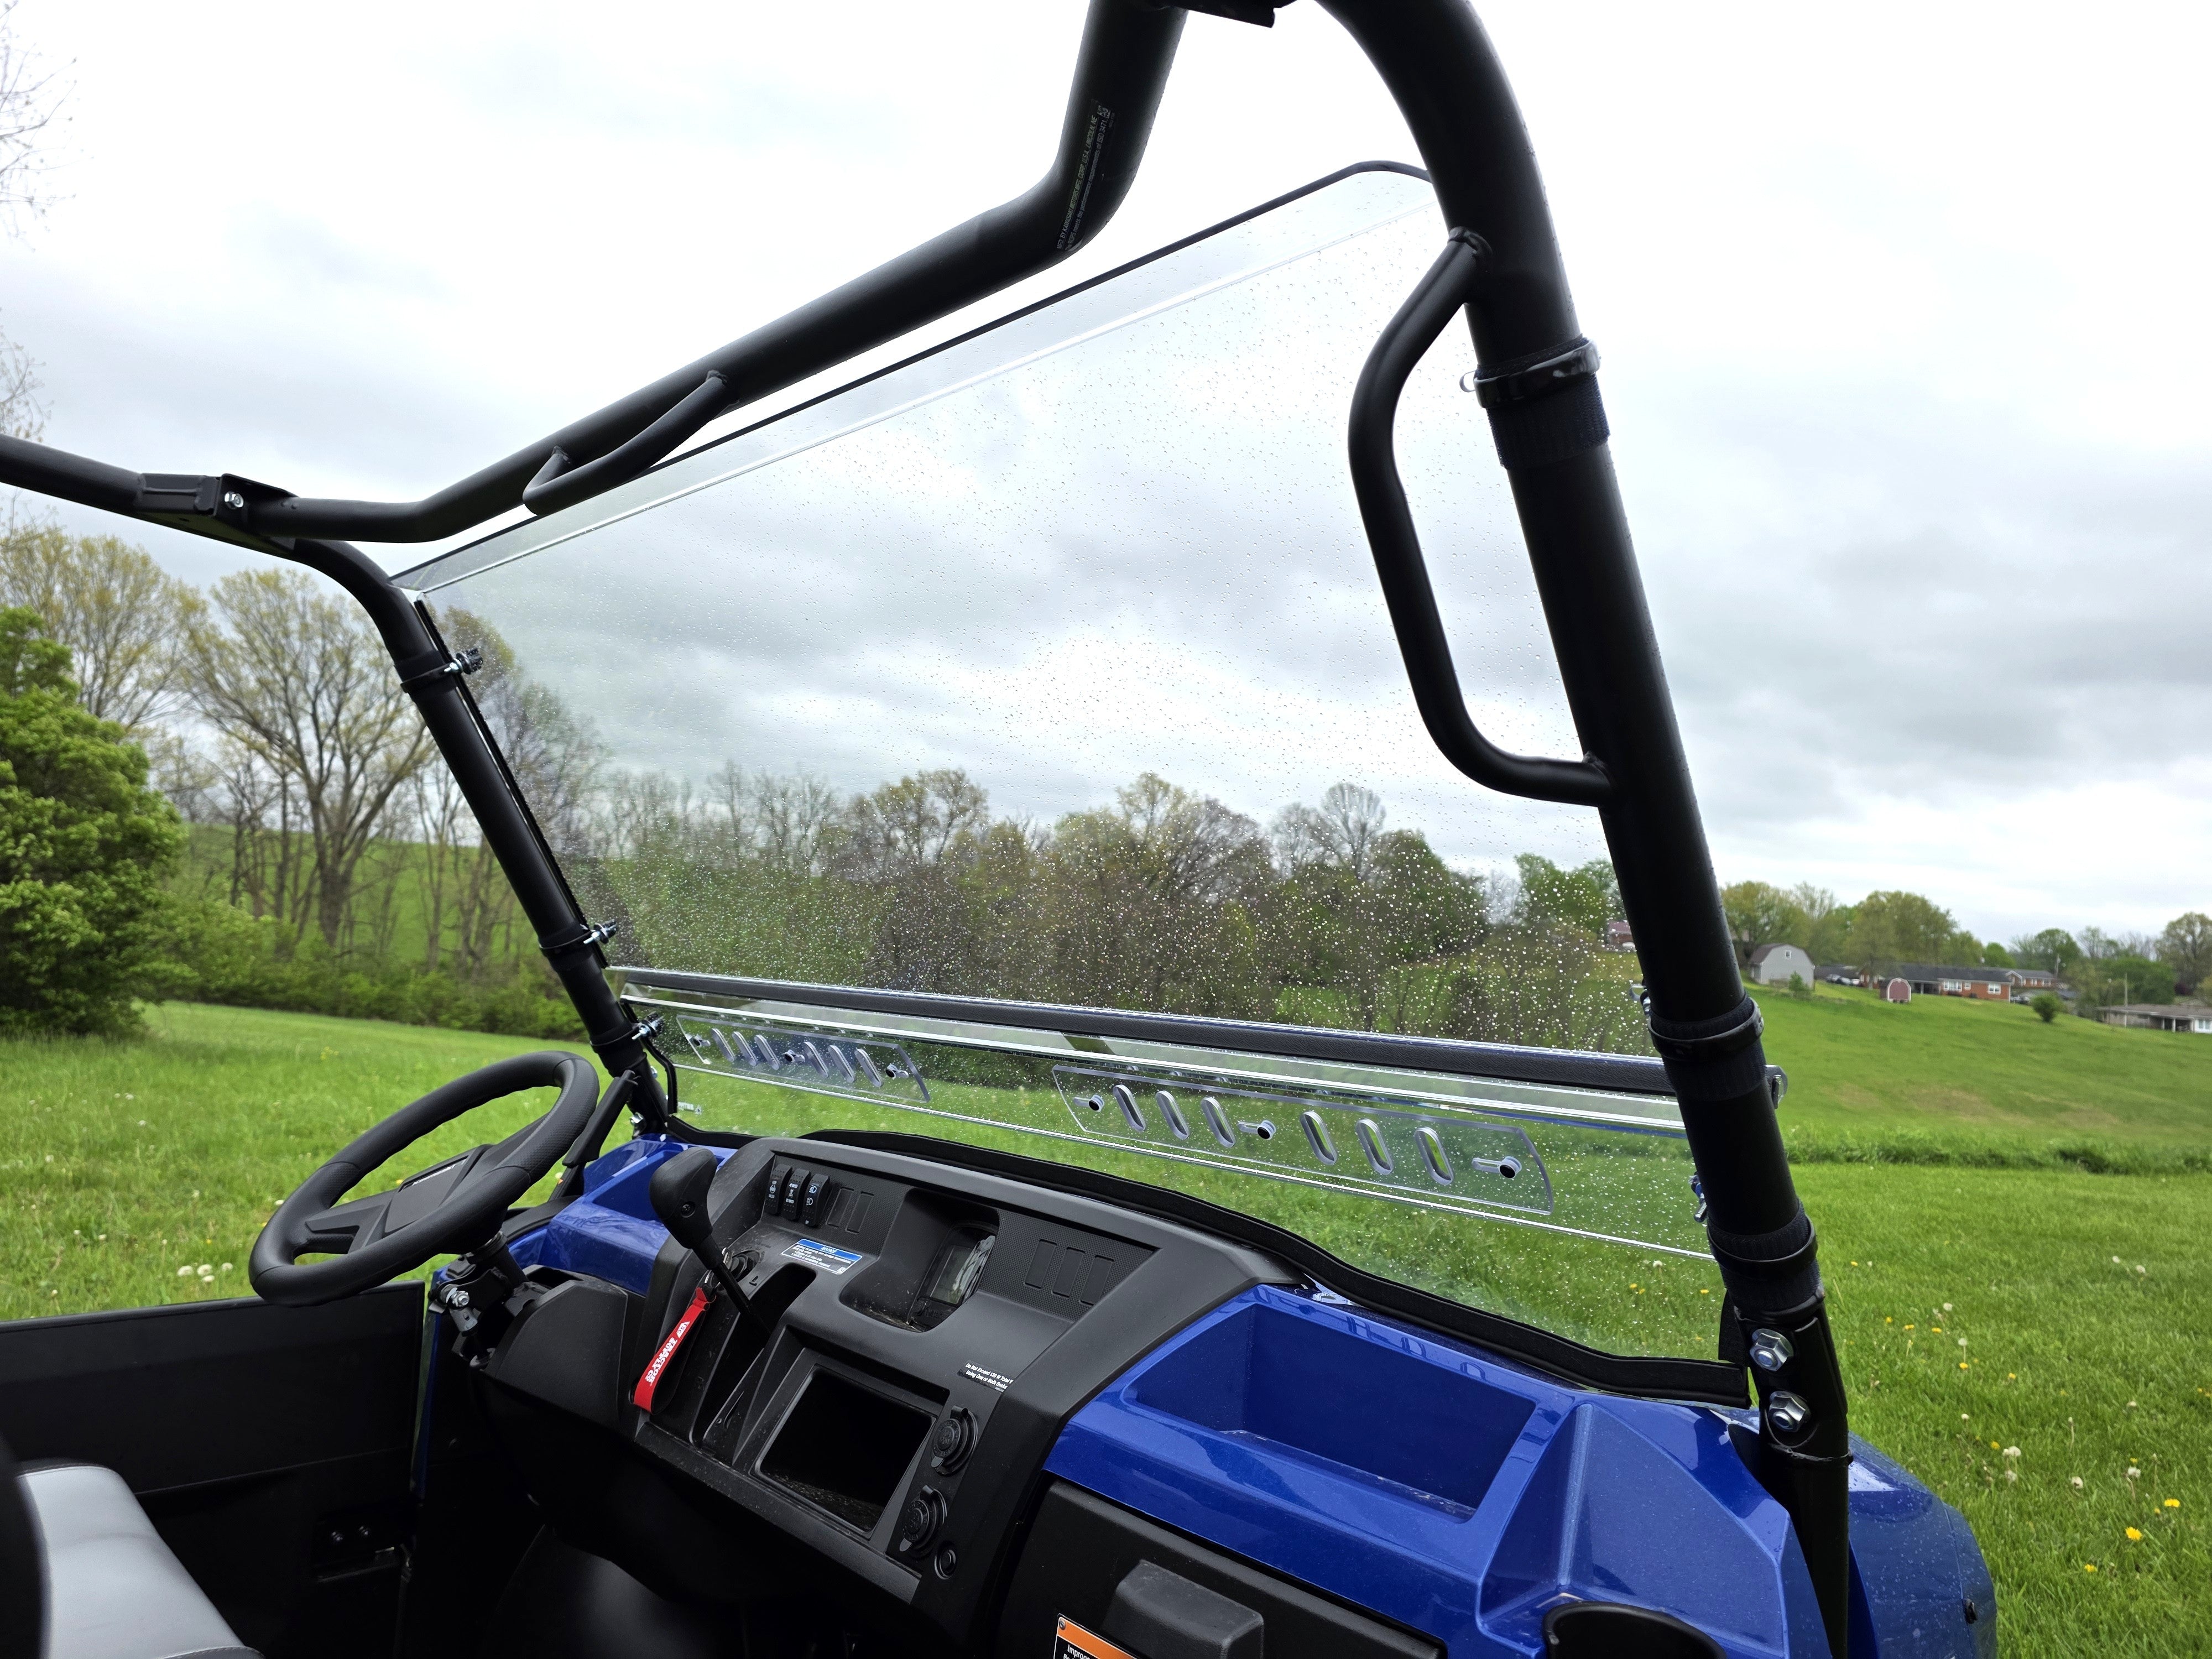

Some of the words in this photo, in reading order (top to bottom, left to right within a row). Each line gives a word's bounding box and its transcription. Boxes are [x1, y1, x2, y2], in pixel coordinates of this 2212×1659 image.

[1070, 186, 1079, 210] MOTORS
[1062, 207, 1073, 232] KAWASAKI
[1060, 231, 1066, 239] BY
[677, 1323, 687, 1334] TSC
[649, 1338, 677, 1383] TRACTOR
[652, 1337, 674, 1369] SUPPLY
